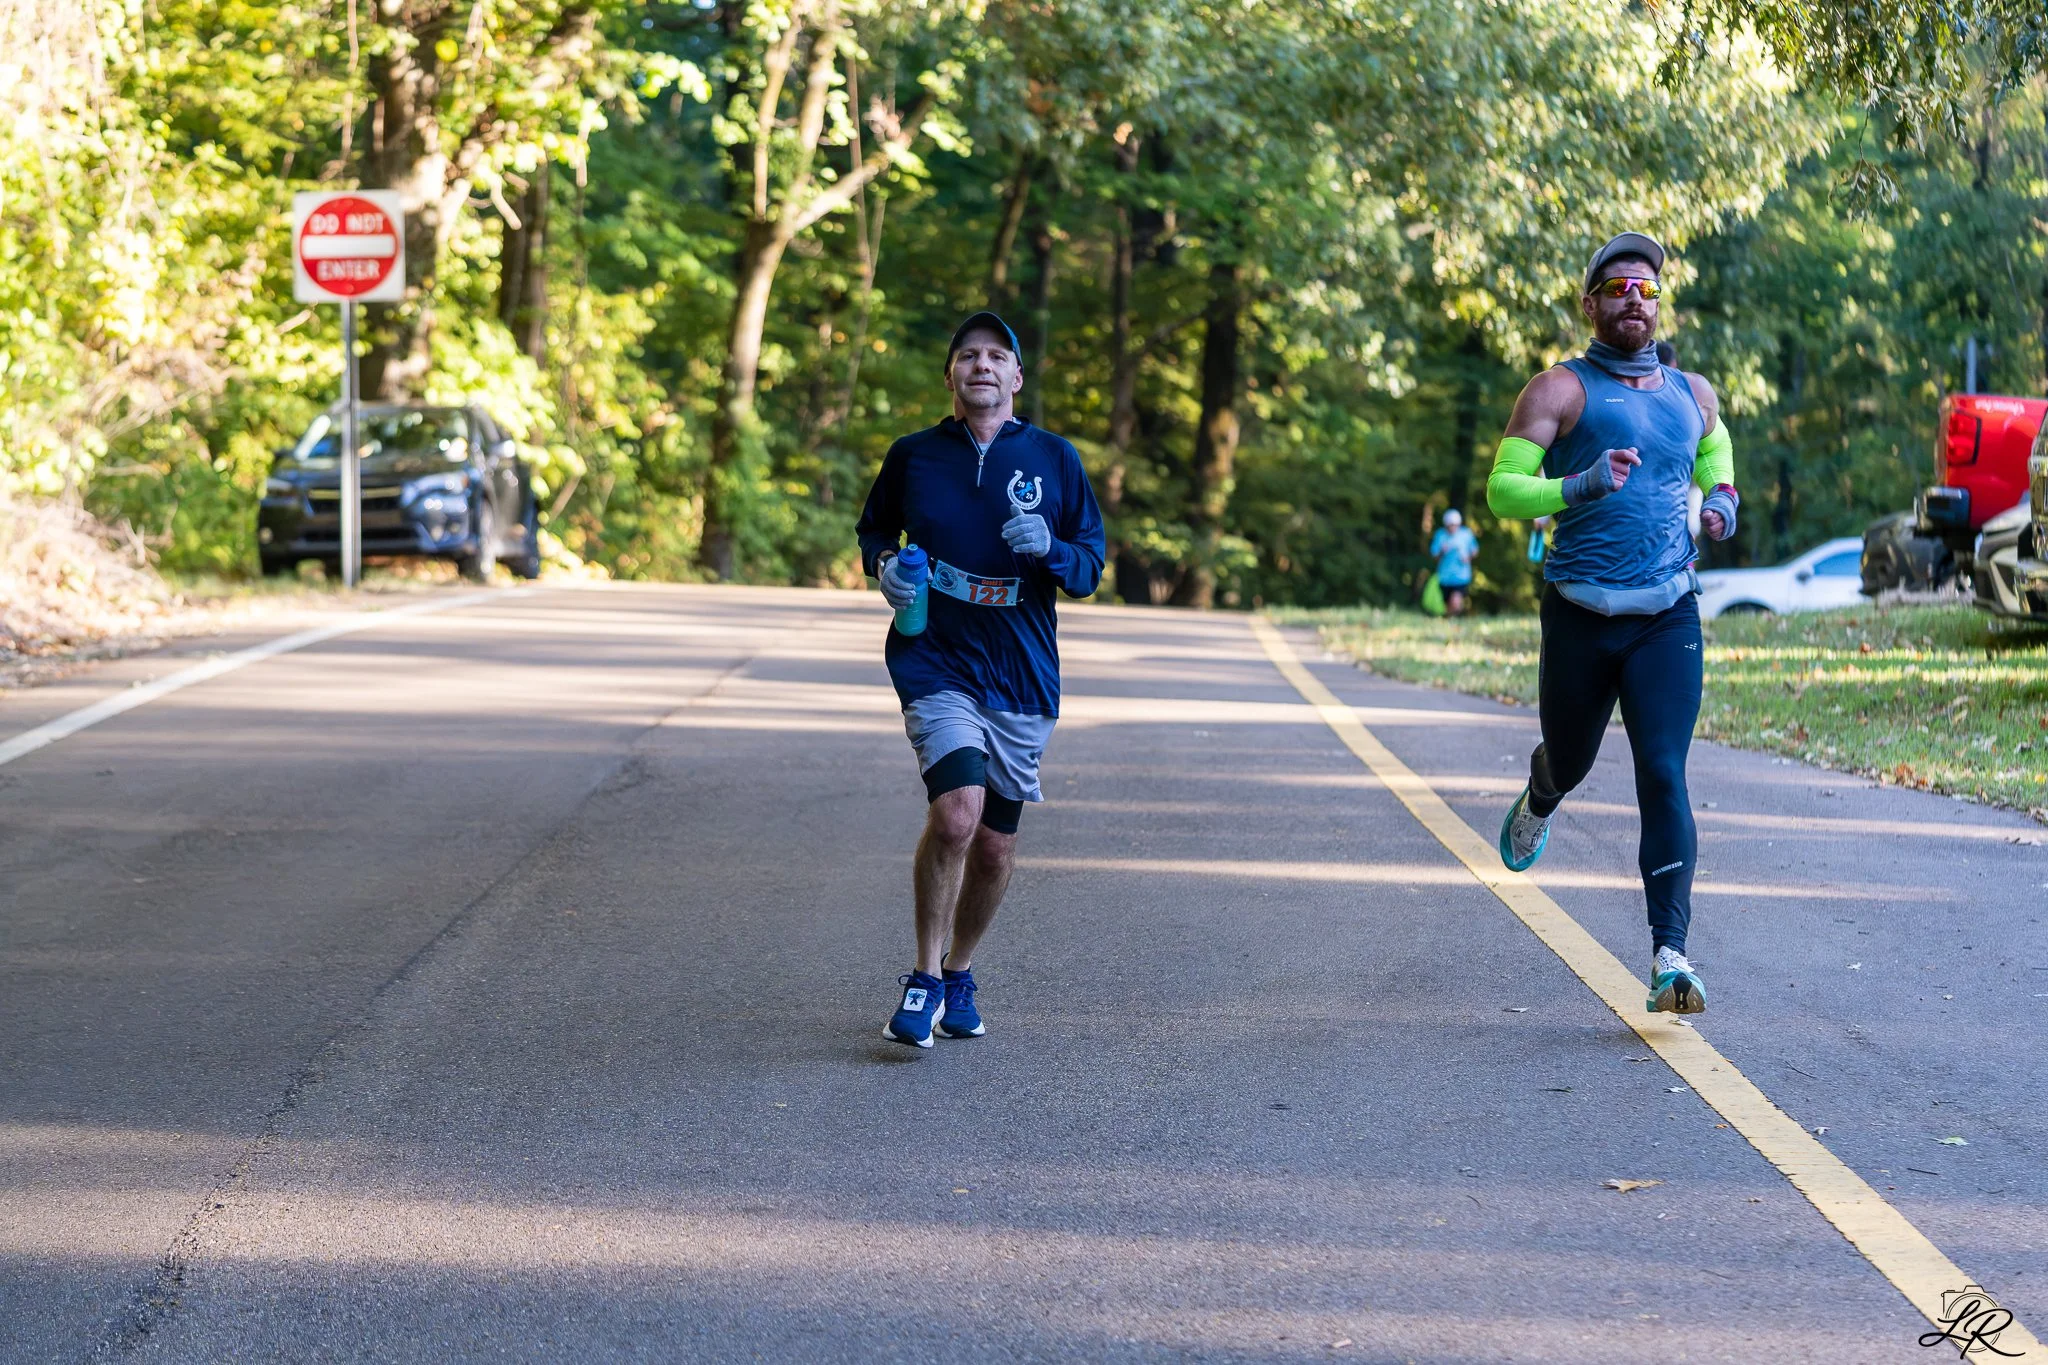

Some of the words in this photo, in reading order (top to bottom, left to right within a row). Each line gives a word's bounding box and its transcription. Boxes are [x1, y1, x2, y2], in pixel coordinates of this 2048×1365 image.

[309, 213, 340, 234] DO
[345, 212, 383, 234] NOT
[317, 259, 380, 281] ENTER
[1017, 480, 1026, 488] 20
[1025, 492, 1034, 500] 24
[969, 584, 1009, 605] 122
